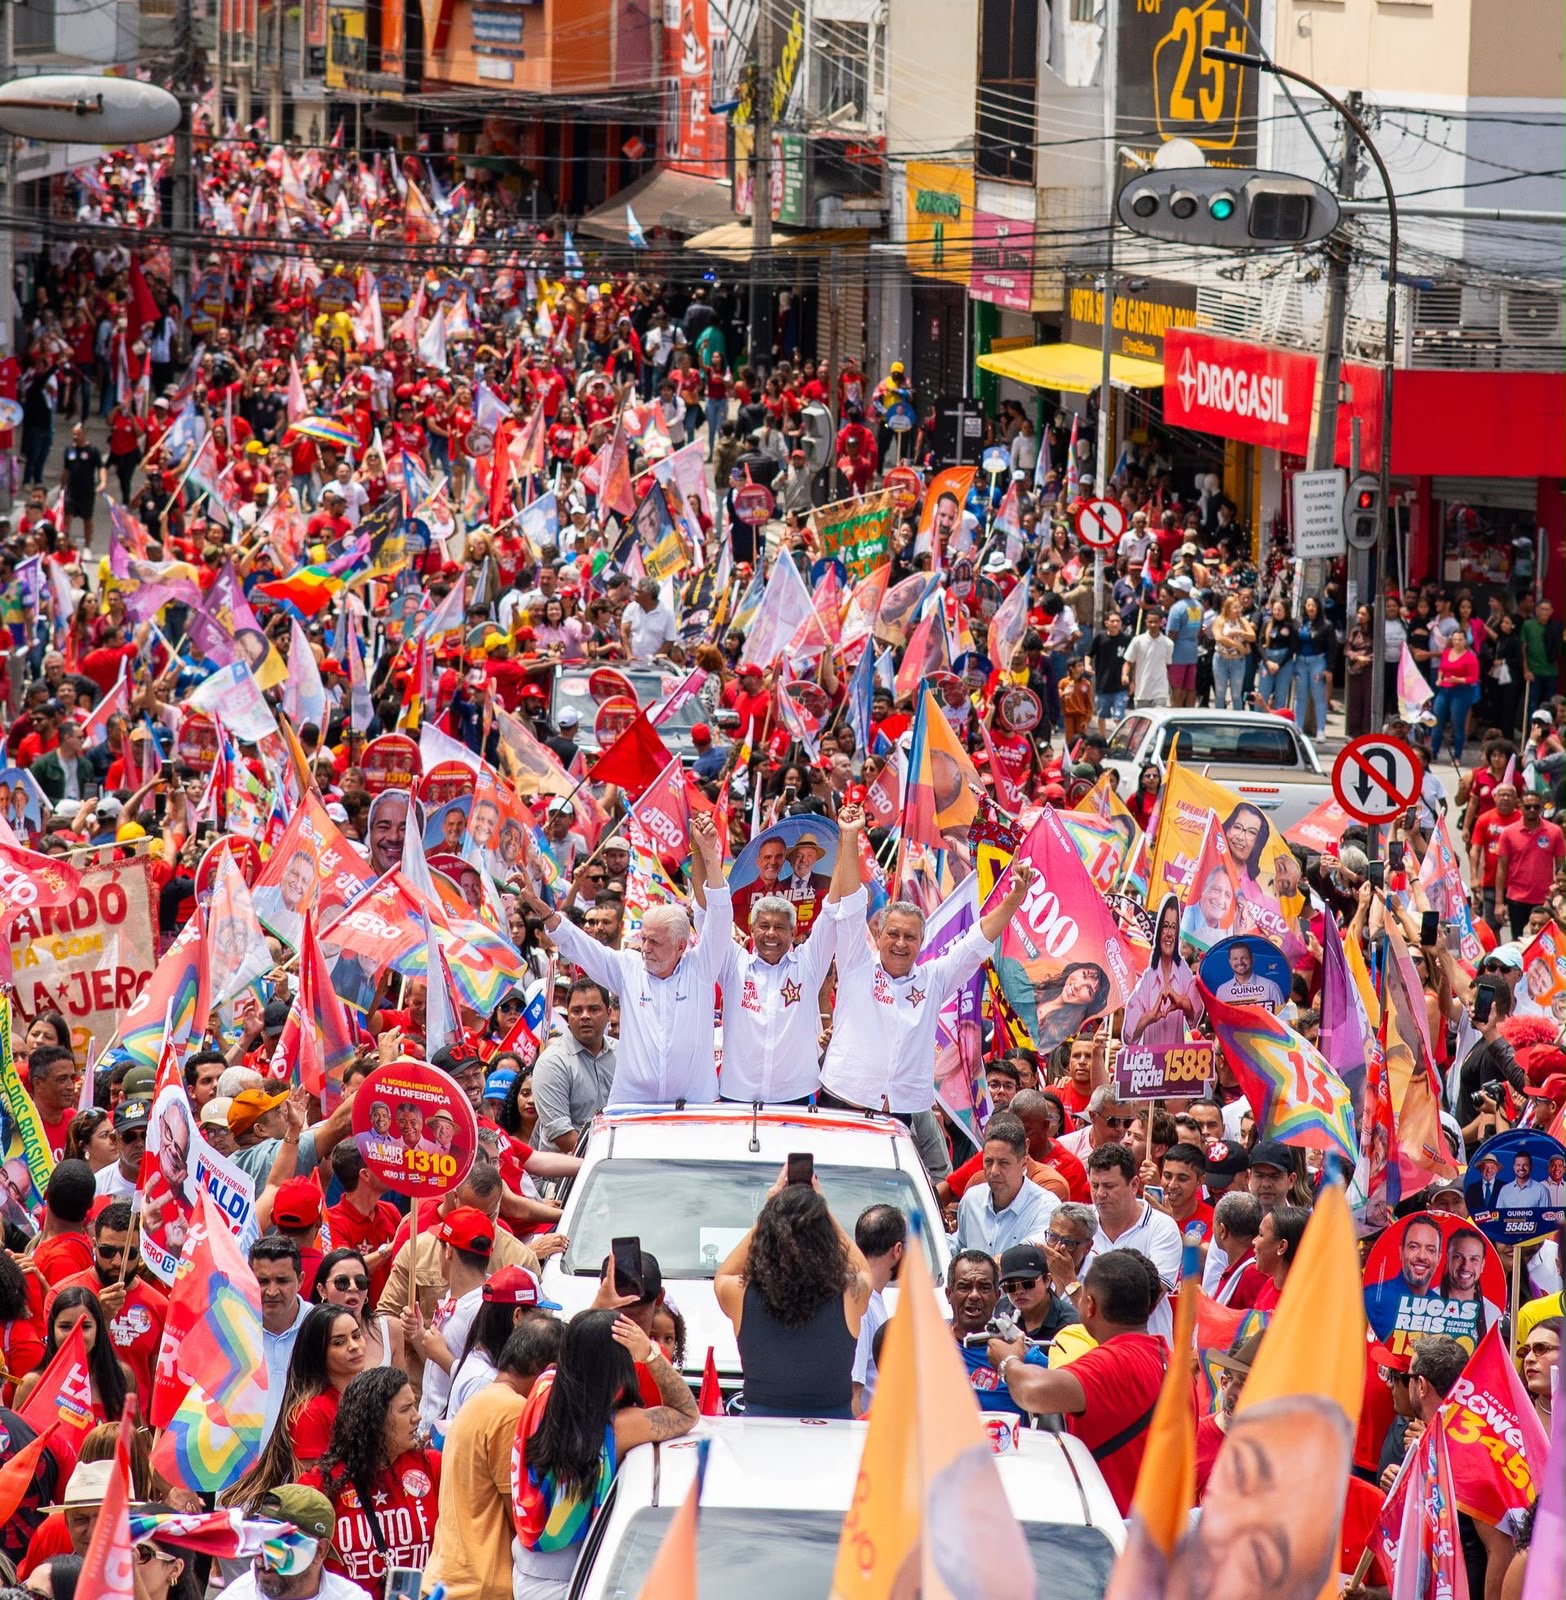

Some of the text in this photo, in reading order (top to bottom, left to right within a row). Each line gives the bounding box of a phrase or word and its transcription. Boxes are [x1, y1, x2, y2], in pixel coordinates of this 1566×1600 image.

[1070, 287, 1094, 323] VISTA
[1127, 298, 1173, 337] GASTANDO
[1197, 360, 1289, 425] DROGASIL
[1302, 478, 1336, 487] PEDESTRE
[1303, 491, 1336, 499] AGUARDE
[1302, 529, 1339, 537] ATRAVESSE
[1306, 517, 1328, 525] VERDE
[857, 543, 883, 556] COM
[386, 773, 411, 782] 1310
[641, 807, 683, 848] JERO
[1048, 817, 1070, 853] Partido Verde
[1090, 841, 1119, 894] 13
[1011, 856, 1079, 958] 300
[341, 911, 401, 939] JERO
[51, 933, 103, 961] COM
[1123, 1047, 1212, 1081] Lúcia 1588
[388, 1078, 412, 1089] NOSSA
[411, 1081, 444, 1094] HISTÓRIA
[1130, 1064, 1164, 1095] Rocha
[1287, 1051, 1334, 1115] 13
[375, 1084, 451, 1105] FAZ A DIFERENÇA
[365, 1141, 457, 1177] VALMIR 1310
[368, 1152, 403, 1165] ASSUNÇÃO
[199, 1153, 248, 1196] DEPUTADO FEDERAL
[382, 1169, 398, 1179] JERO
[1505, 1222, 1535, 1231] 55455
[143, 1241, 175, 1272] JERO 13
[1398, 1296, 1478, 1320] LUCAS
[1395, 1314, 1474, 1333] REIS DEPUTADO
[1442, 1402, 1536, 1503] 1345
[338, 1516, 353, 1552] O
[416, 1499, 430, 1542] É
